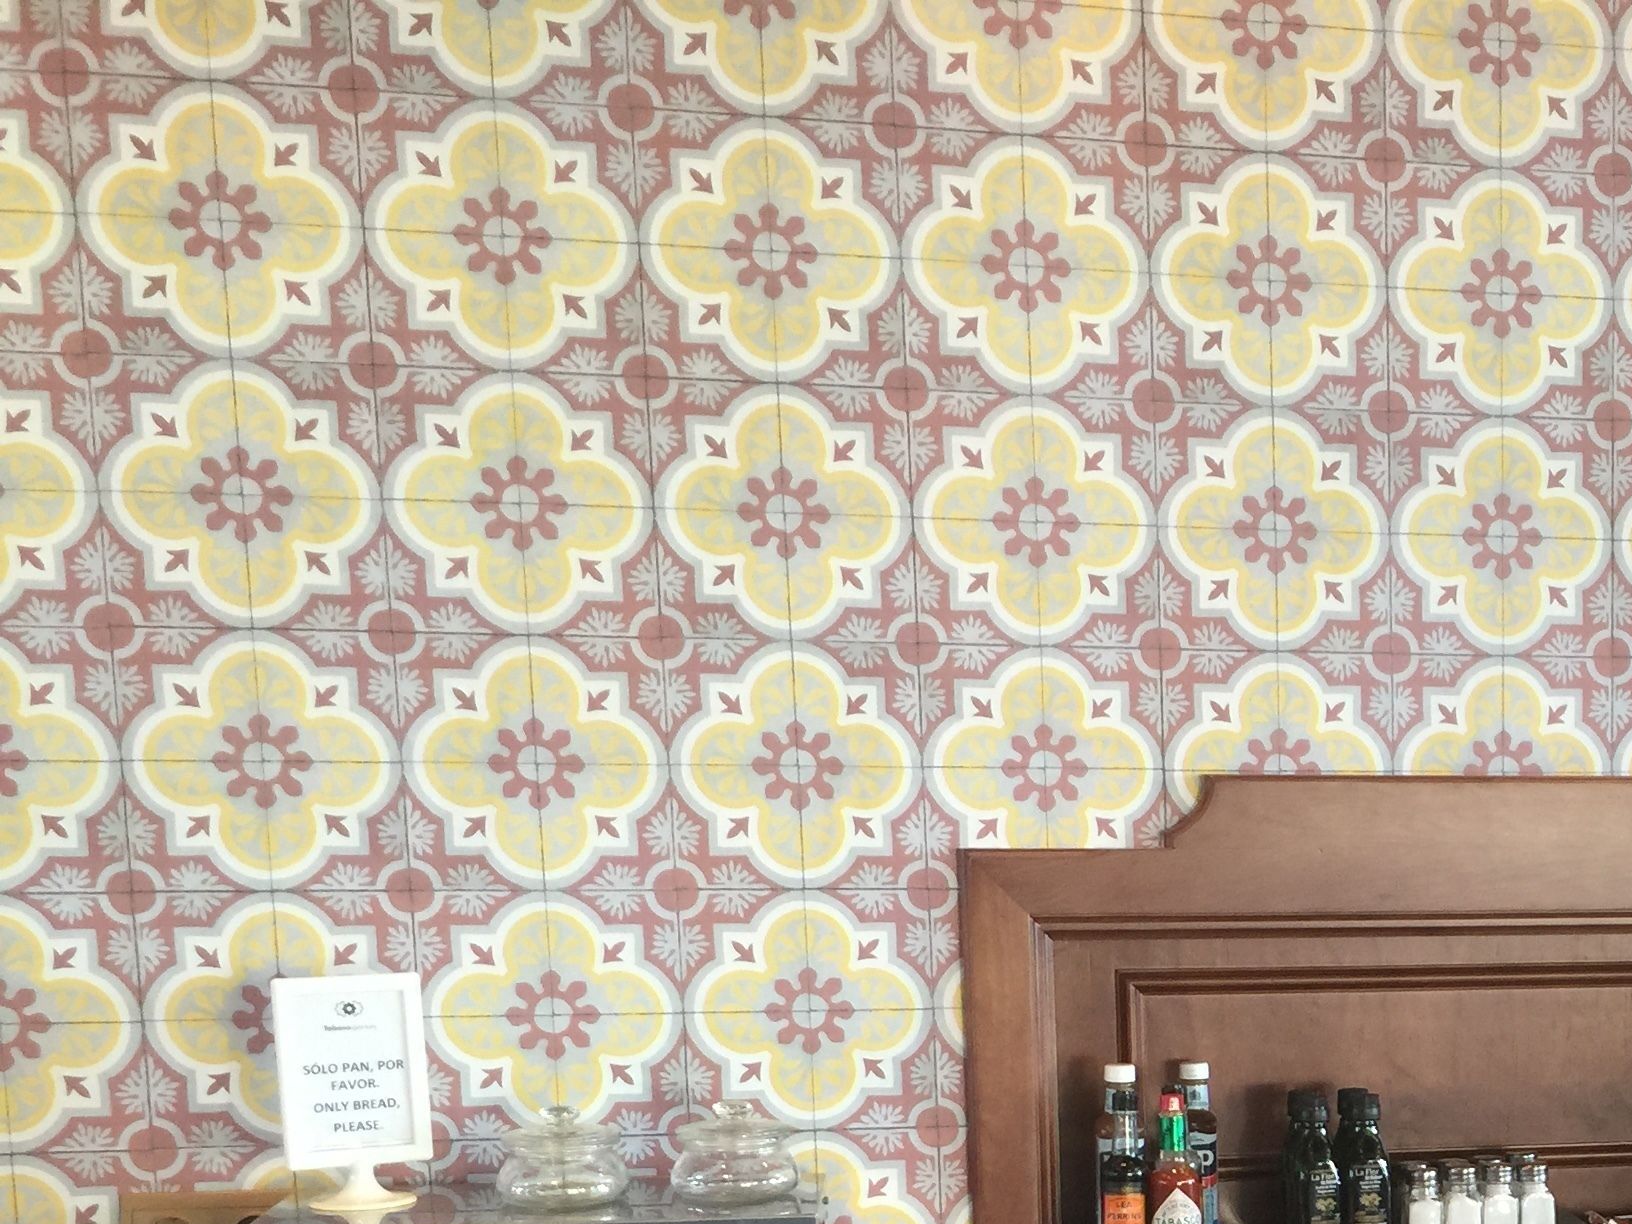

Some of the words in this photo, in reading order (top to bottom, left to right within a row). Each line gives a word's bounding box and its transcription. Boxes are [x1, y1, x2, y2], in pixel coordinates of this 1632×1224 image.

[342, 1062, 373, 1072] PAN,
[377, 1059, 404, 1070] POR
[331, 1078, 380, 1090] FAVOR.
[313, 1101, 349, 1113] ONLY
[353, 1098, 401, 1110] BREAD,
